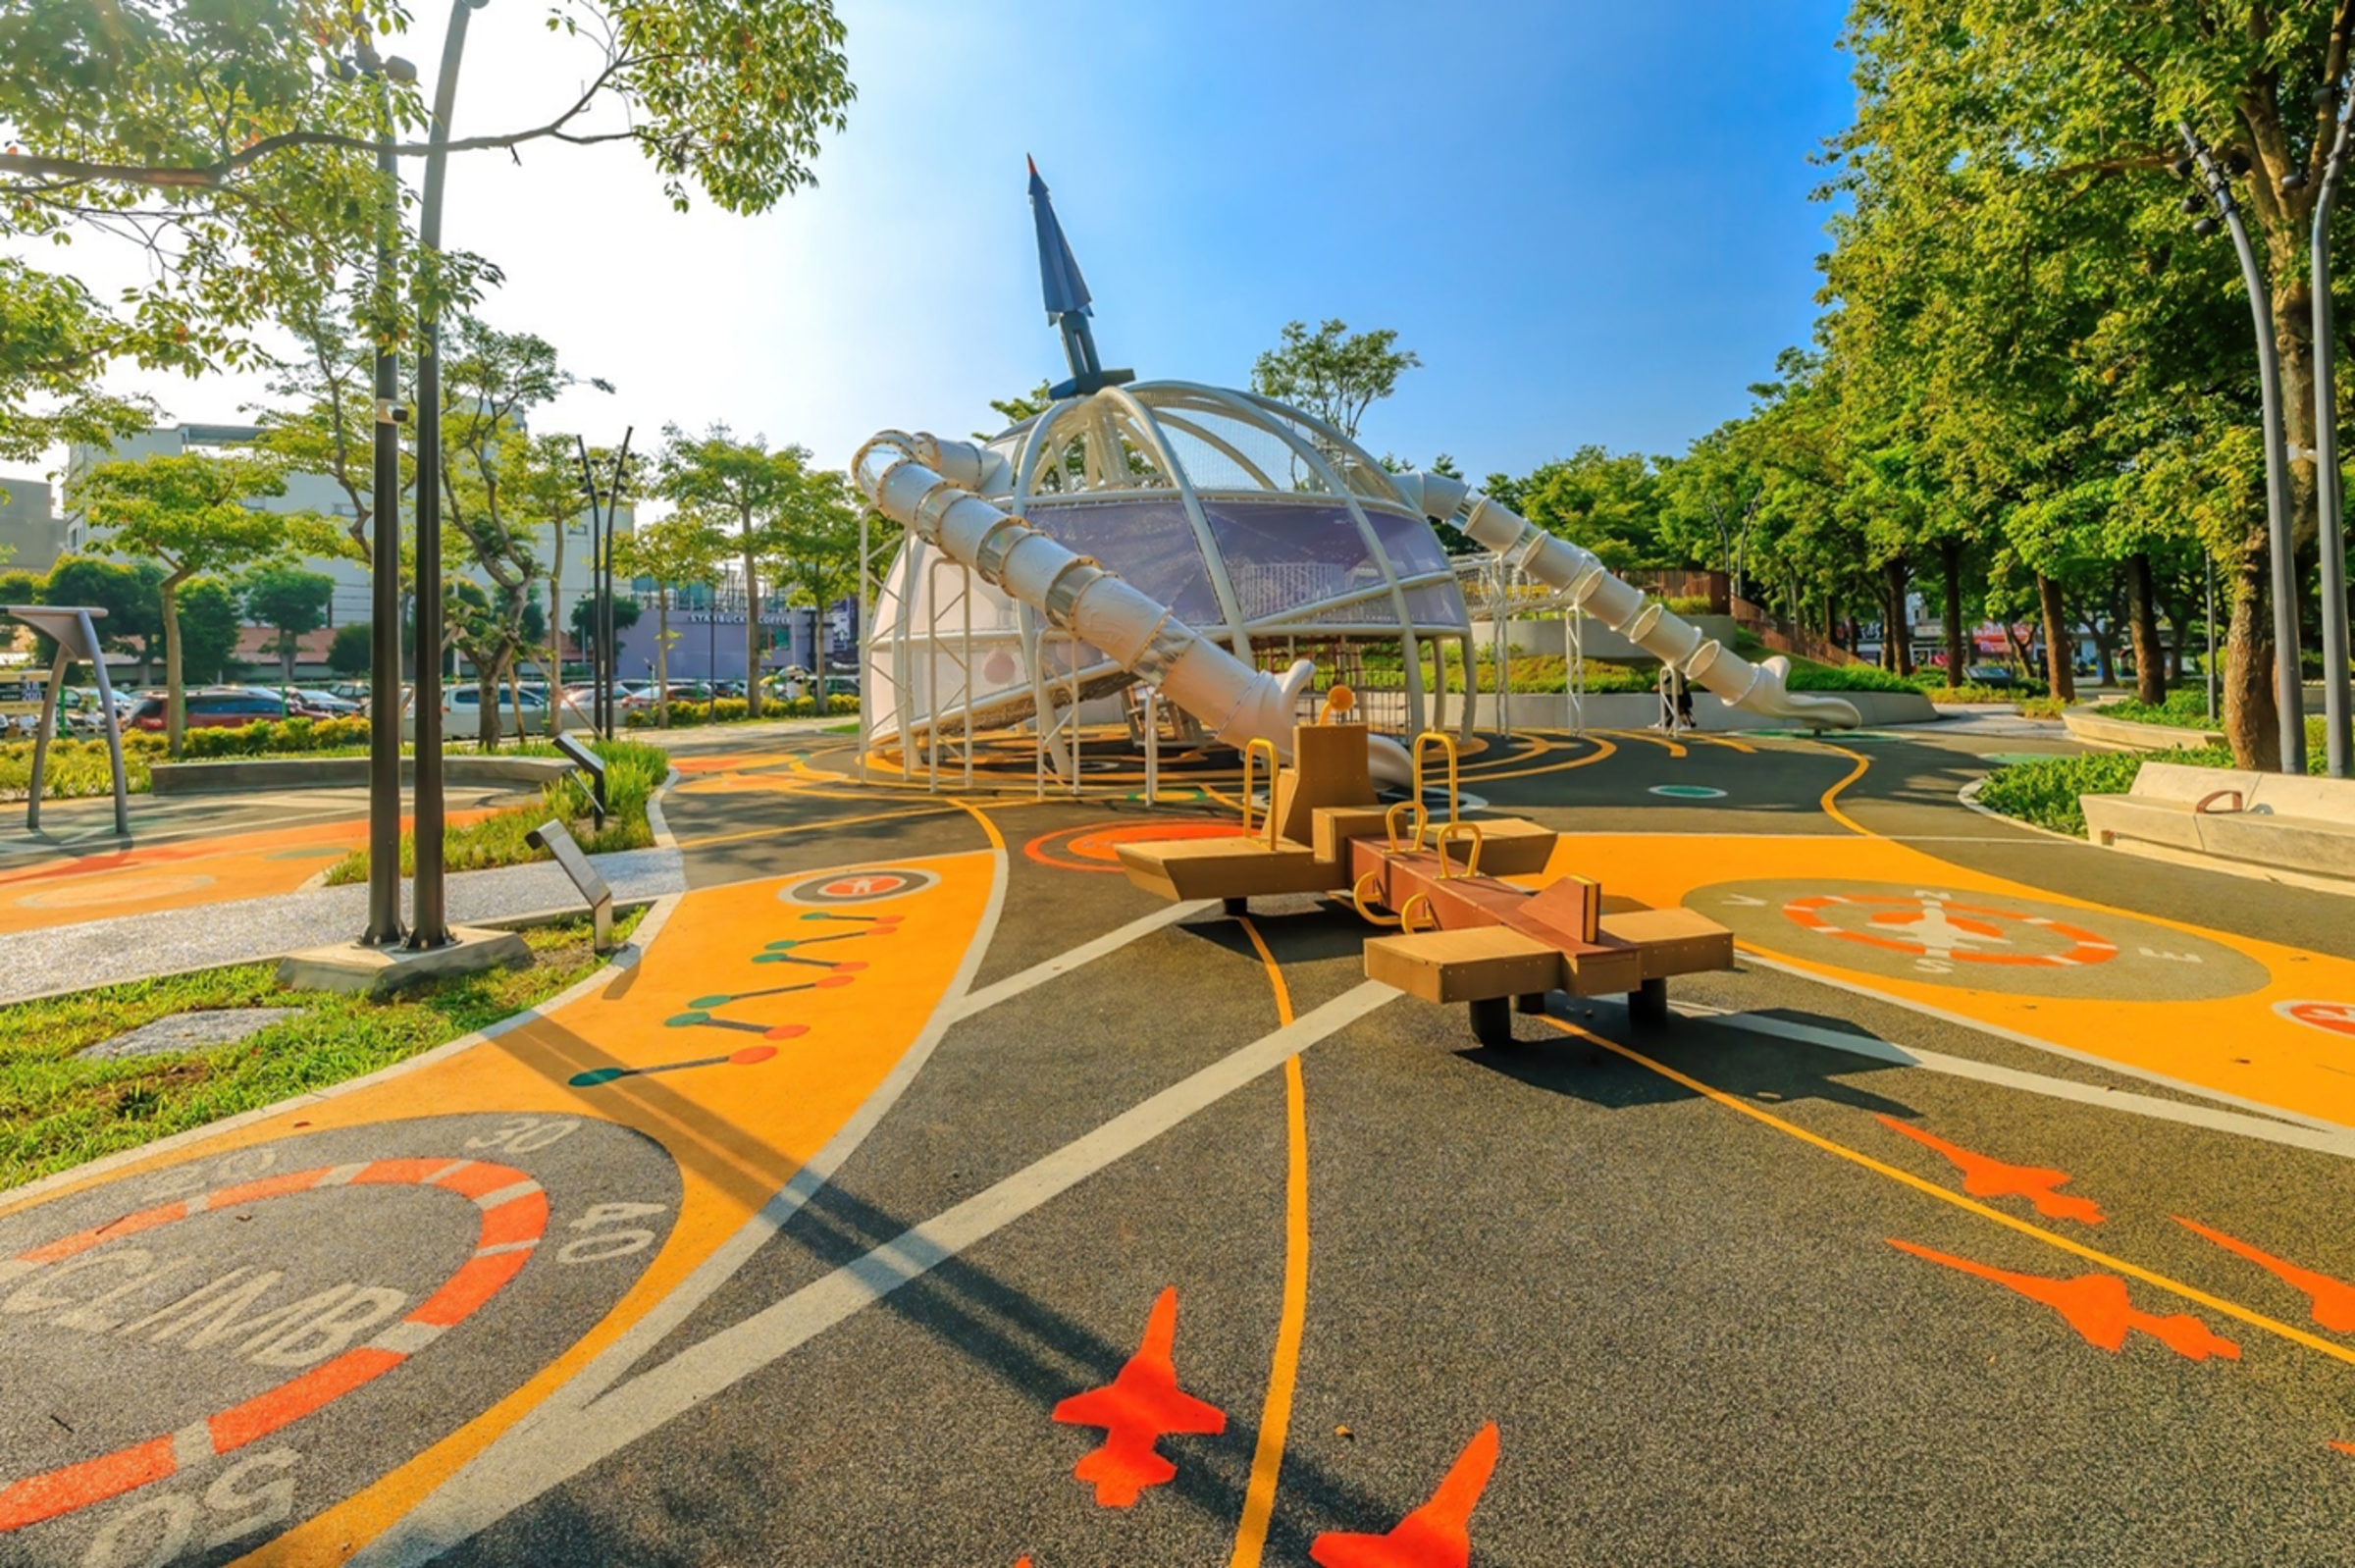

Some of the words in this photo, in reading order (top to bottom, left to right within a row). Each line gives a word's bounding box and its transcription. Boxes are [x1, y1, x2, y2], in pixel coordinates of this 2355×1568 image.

[691, 614, 746, 624] STABUCK
[758, 615, 791, 625] COFFEE
[464, 1117, 582, 1155] 30
[555, 1202, 668, 1263] 40
[0, 1248, 409, 1368] CLIMB
[78, 1446, 303, 1568] 50
